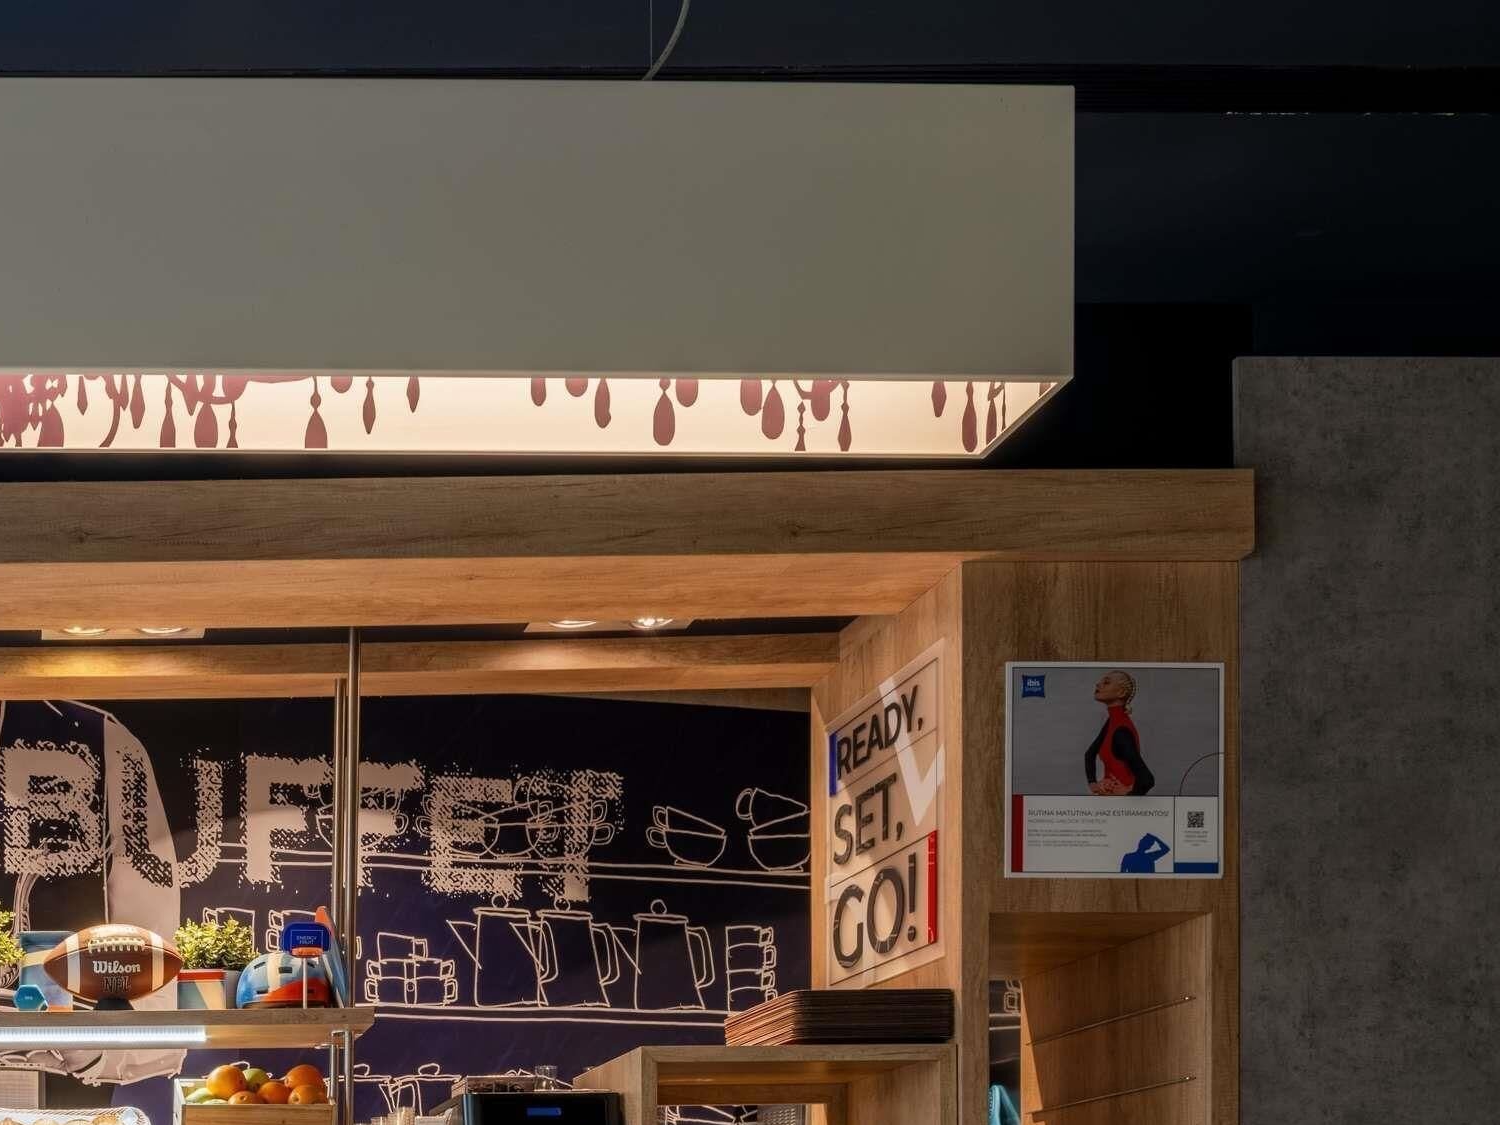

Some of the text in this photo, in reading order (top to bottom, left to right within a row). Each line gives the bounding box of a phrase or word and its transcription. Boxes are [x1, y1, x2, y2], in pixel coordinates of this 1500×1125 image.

[836, 684, 924, 781] READY,
[833, 773, 904, 866] SET,
[833, 852, 918, 969] GO!
[92, 960, 141, 974] Wilson
[102, 976, 131, 993] NFL
